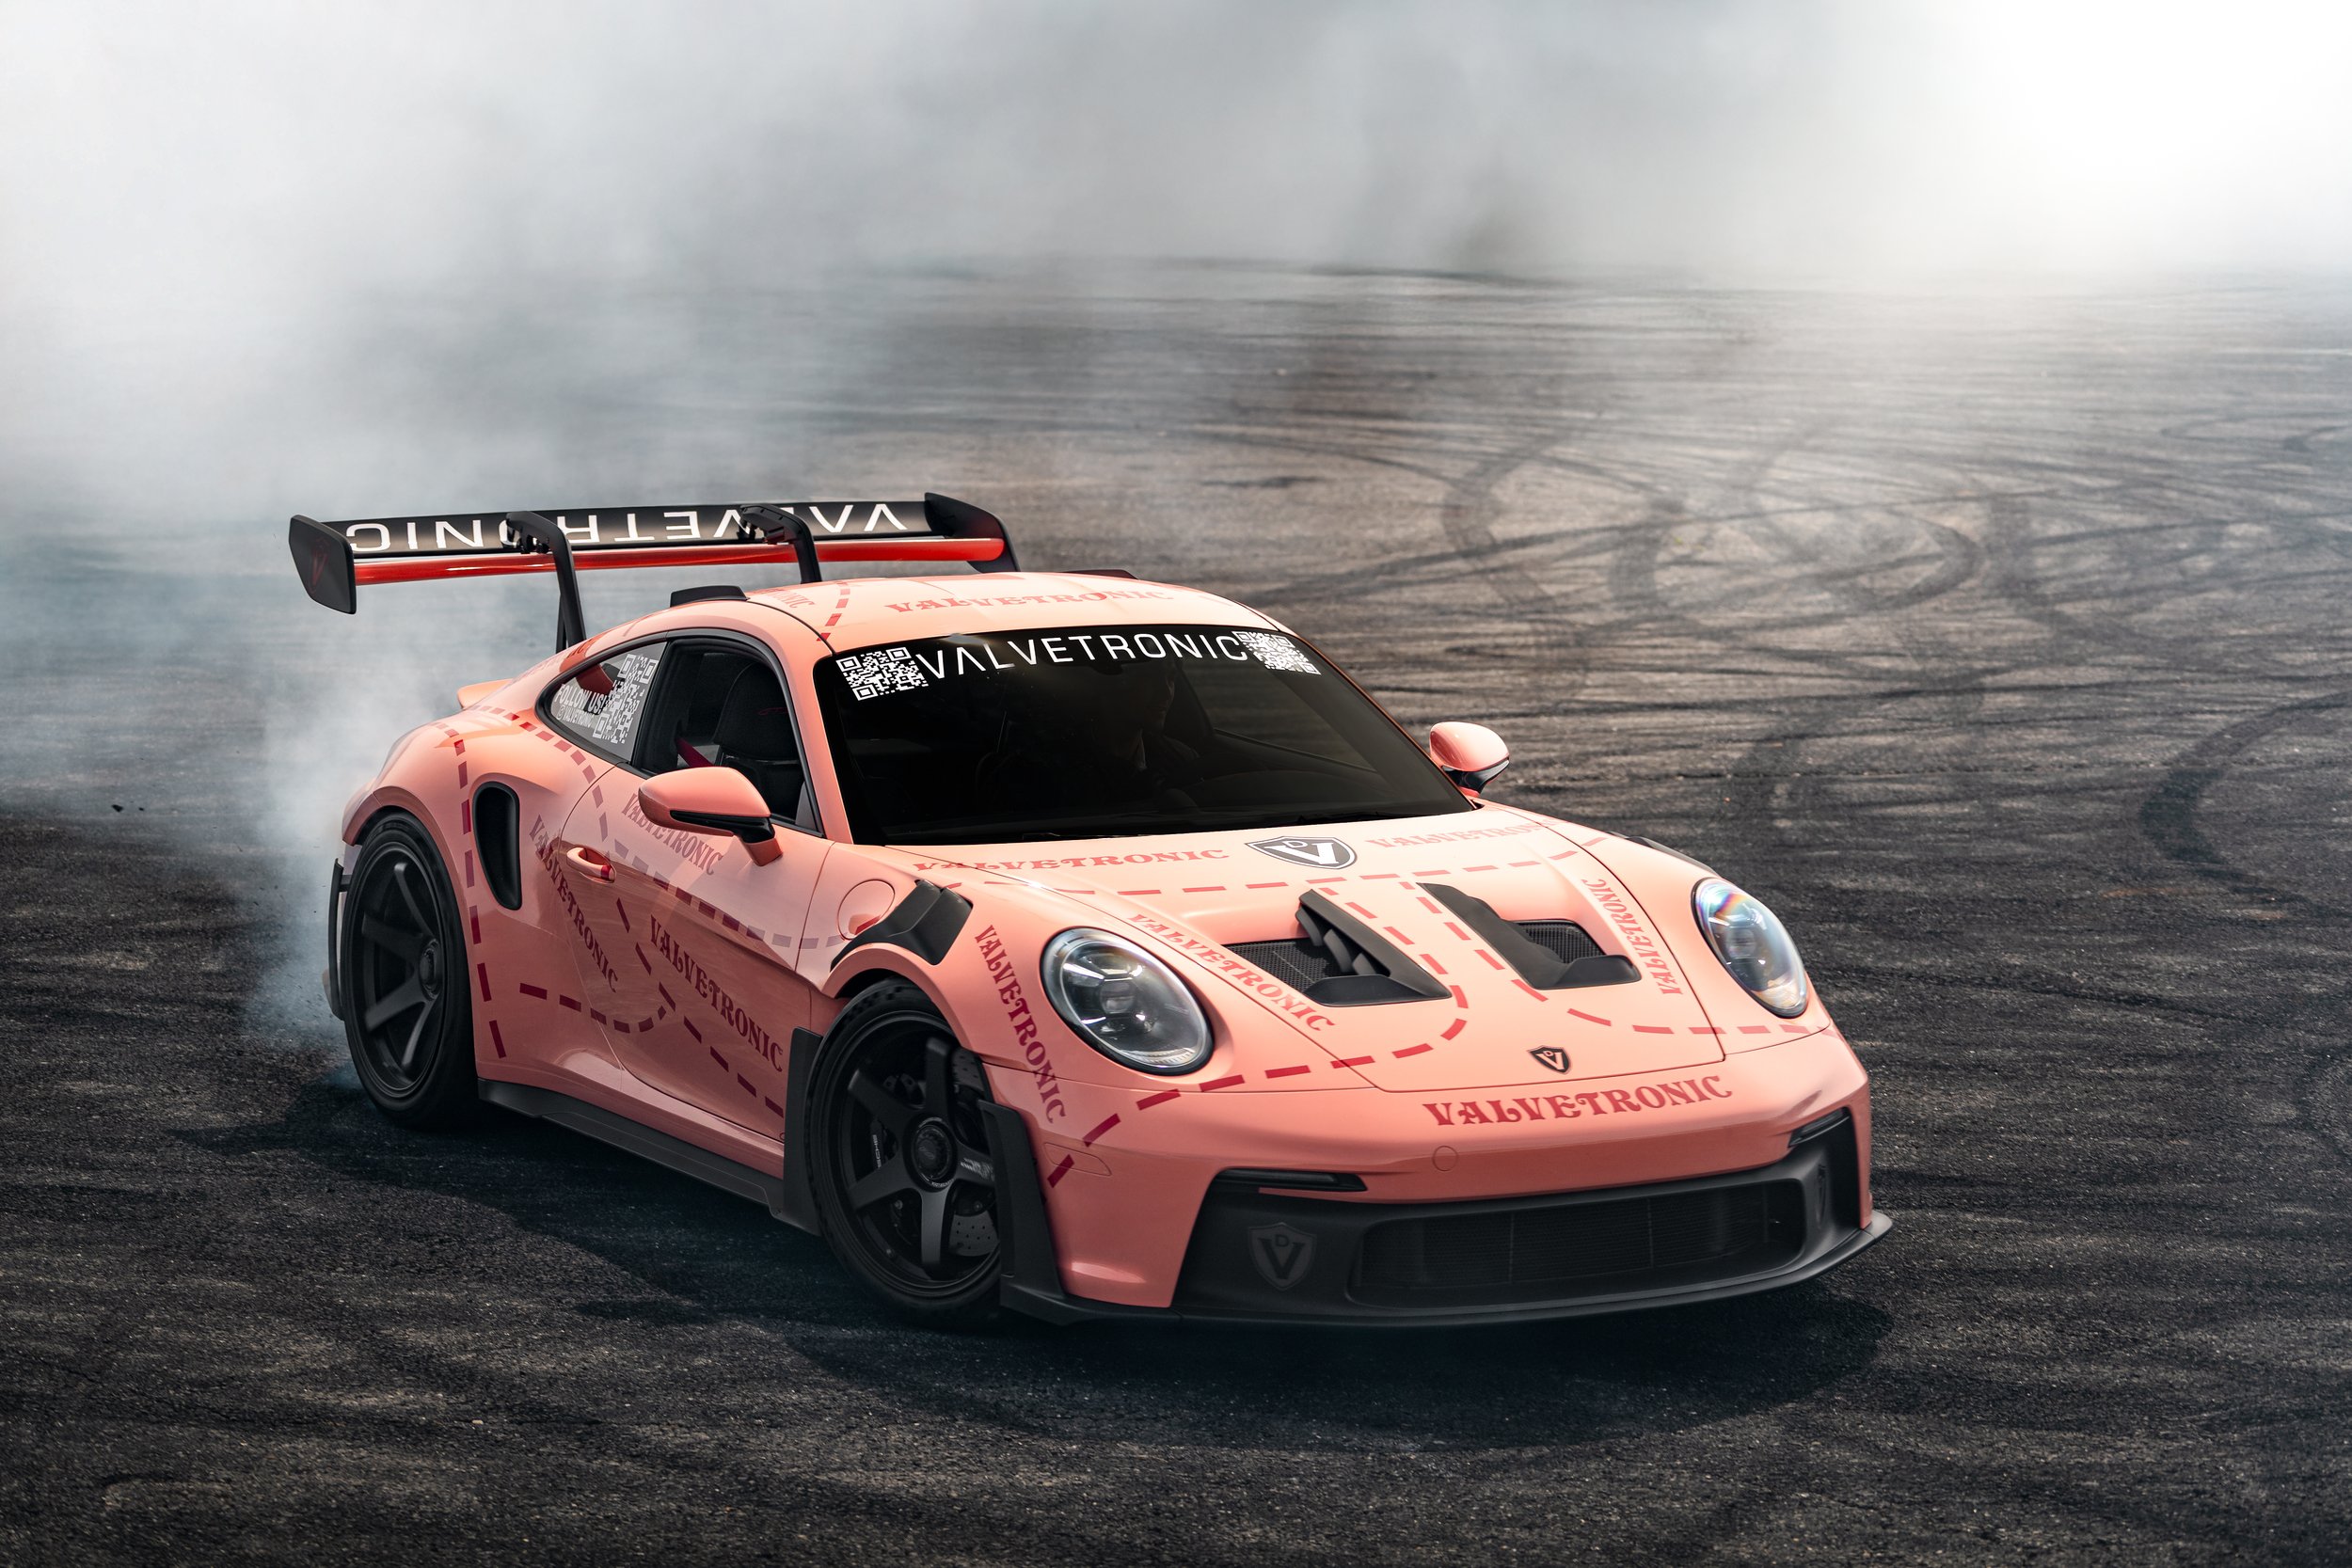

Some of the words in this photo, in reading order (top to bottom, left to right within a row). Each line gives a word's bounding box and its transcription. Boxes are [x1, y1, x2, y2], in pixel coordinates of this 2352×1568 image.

[346, 503, 908, 552] VAVETRNIC
[884, 590, 1173, 612] VALVETRONIC
[915, 632, 1248, 679] VALVETRONIC
[555, 684, 592, 709] FOLLOW
[587, 692, 608, 714] US!
[914, 849, 1231, 872] VALVETRONIC
[529, 815, 619, 993] VALVETRONIC
[1581, 879, 1683, 994] VALVETRONIC
[650, 914, 785, 1072] VALVETRONIC
[1130, 913, 1337, 1032] VALVETRONIC
[975, 925, 1066, 1124] VALVETRONIC
[1422, 1075, 1733, 1126] VALVETRONIC
